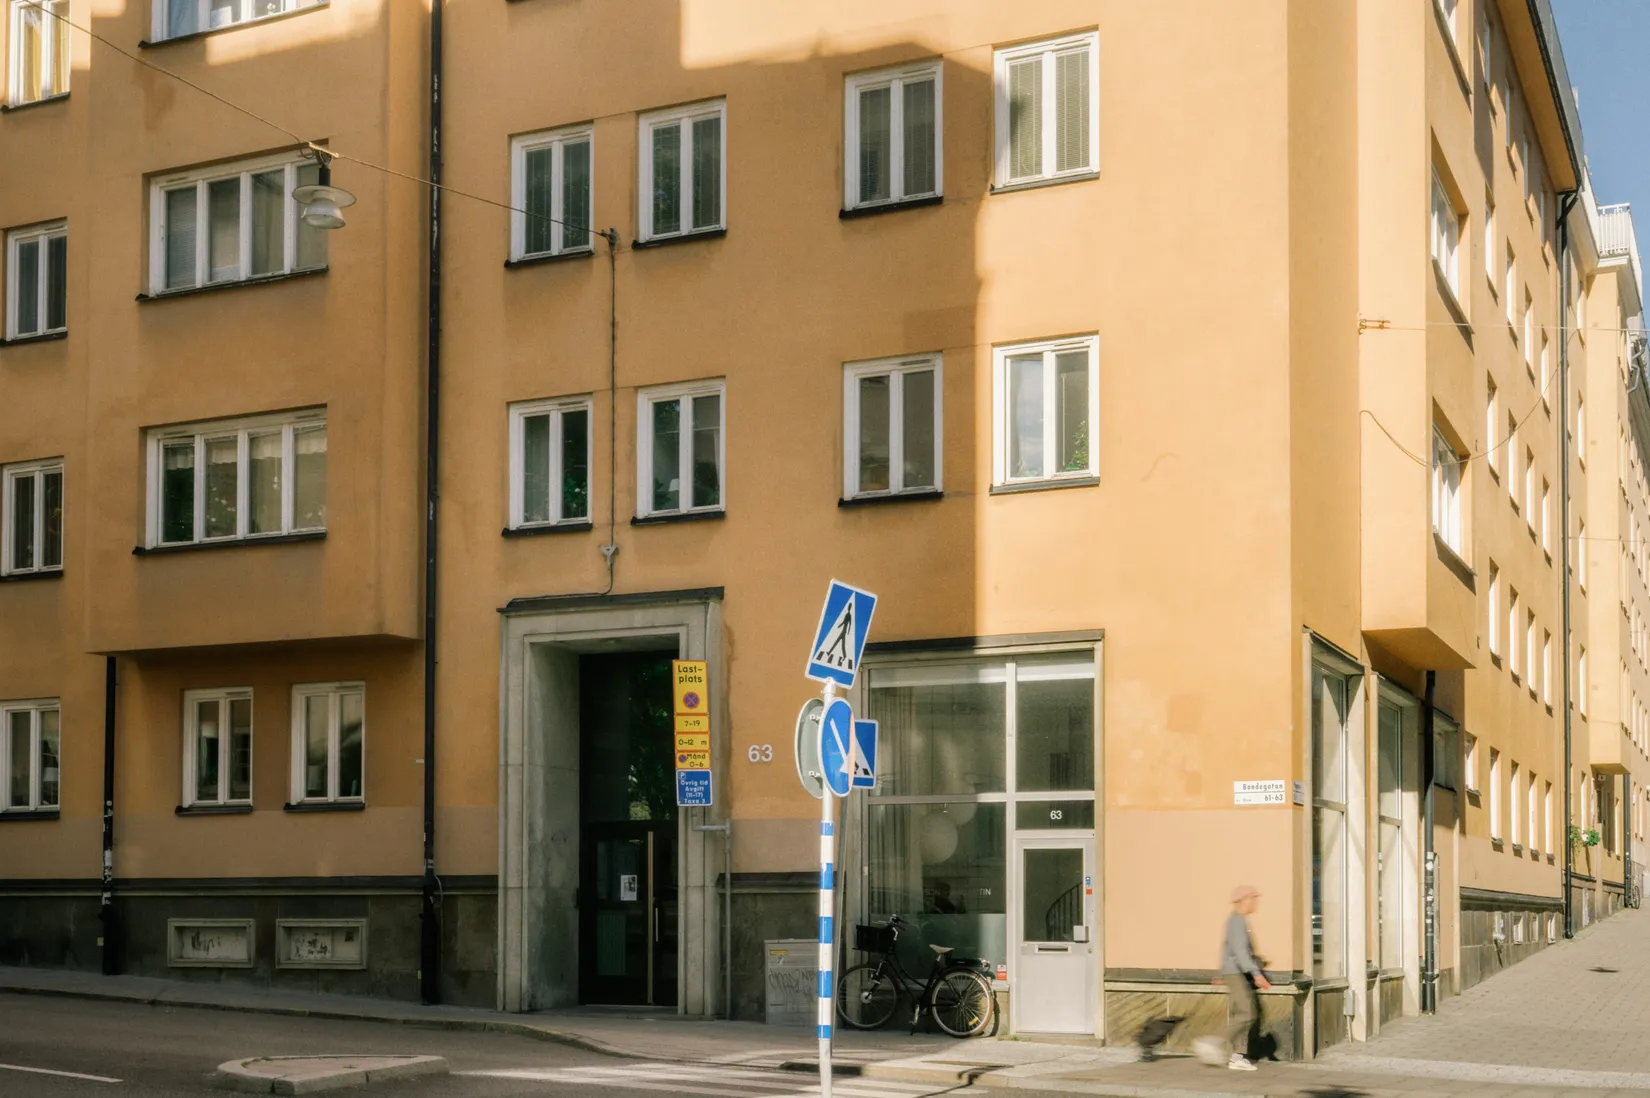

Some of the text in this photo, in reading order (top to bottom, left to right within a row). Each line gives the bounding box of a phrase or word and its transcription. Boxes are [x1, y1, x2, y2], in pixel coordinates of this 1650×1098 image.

[678, 665, 703, 673] Last-
[679, 675, 703, 684] plats
[748, 744, 773, 763] 63
[1243, 783, 1283, 791] Bondegatan
[1050, 810, 1062, 820] 63
